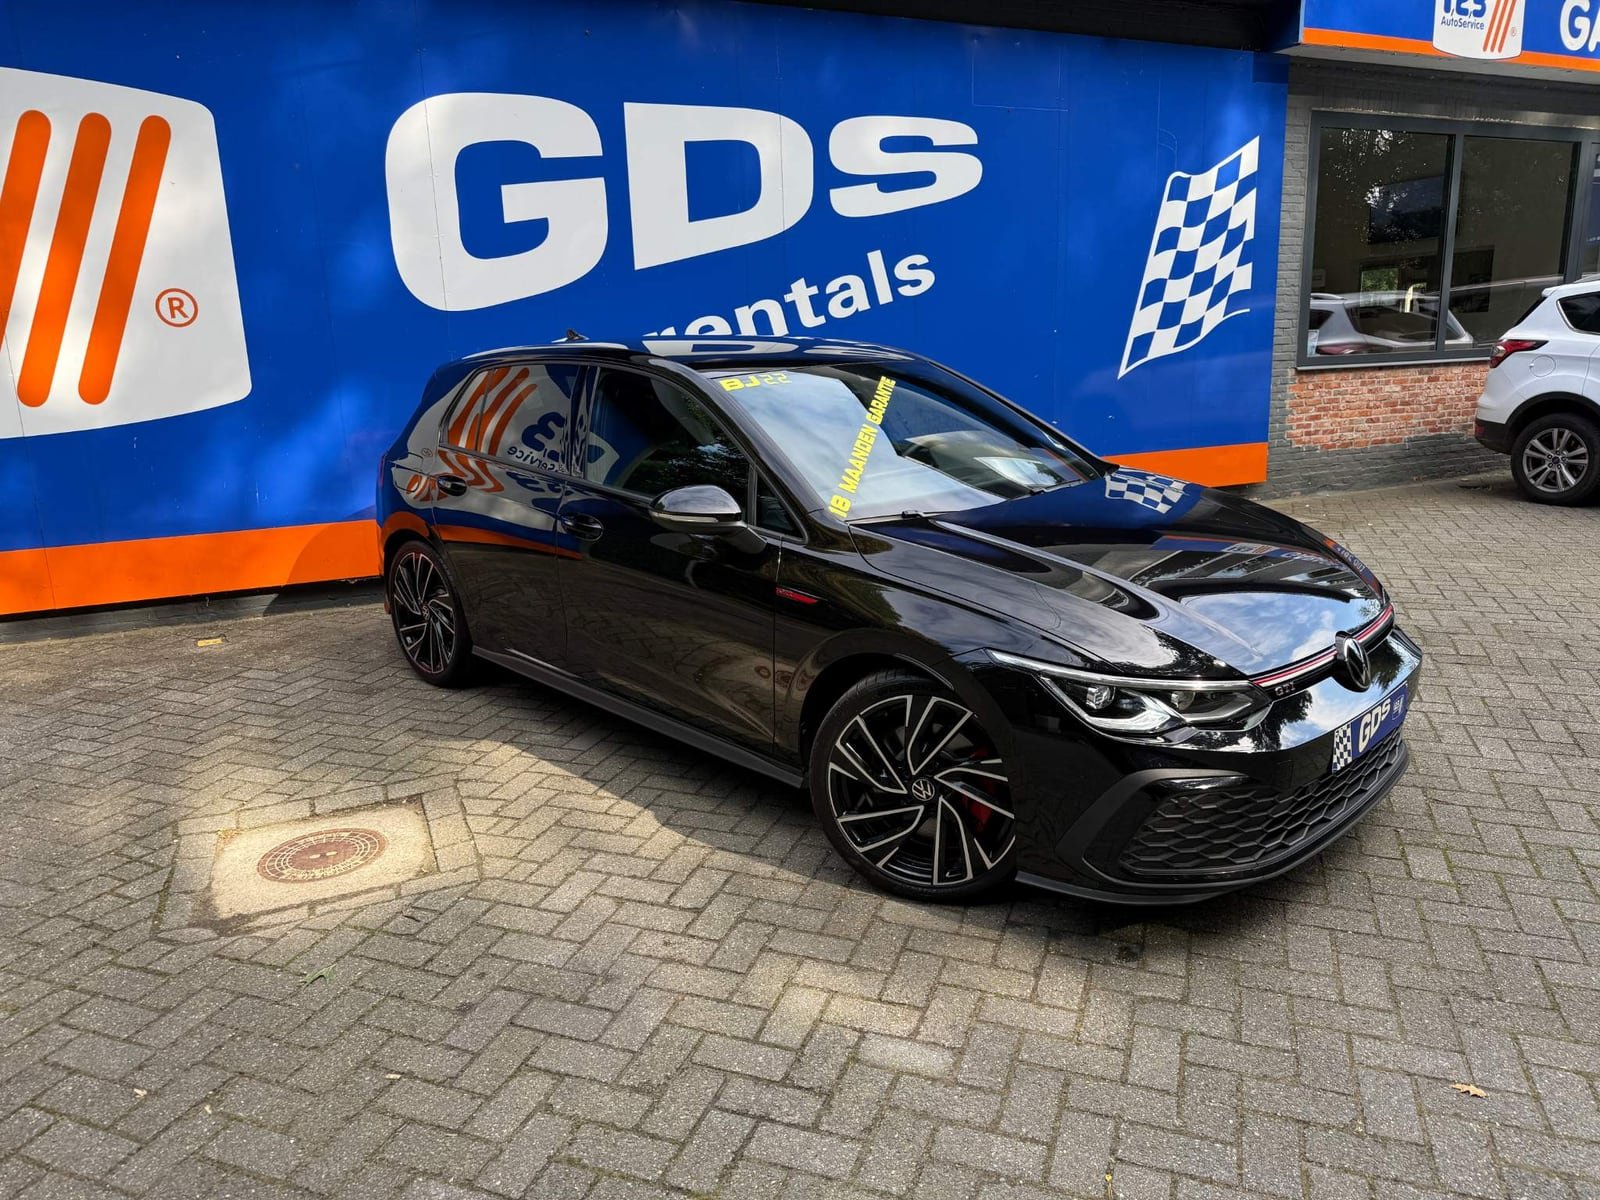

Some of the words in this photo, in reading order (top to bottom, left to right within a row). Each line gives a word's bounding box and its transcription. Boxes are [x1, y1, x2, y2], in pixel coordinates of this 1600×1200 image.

[1440, 16, 1485, 30] AutoService
[385, 92, 983, 312] GDS
[641, 249, 936, 337] ntals
[865, 375, 897, 426] GARANTIE
[838, 423, 879, 494] MAANDEN
[828, 494, 852, 518] 18
[1358, 697, 1392, 753] GDS
